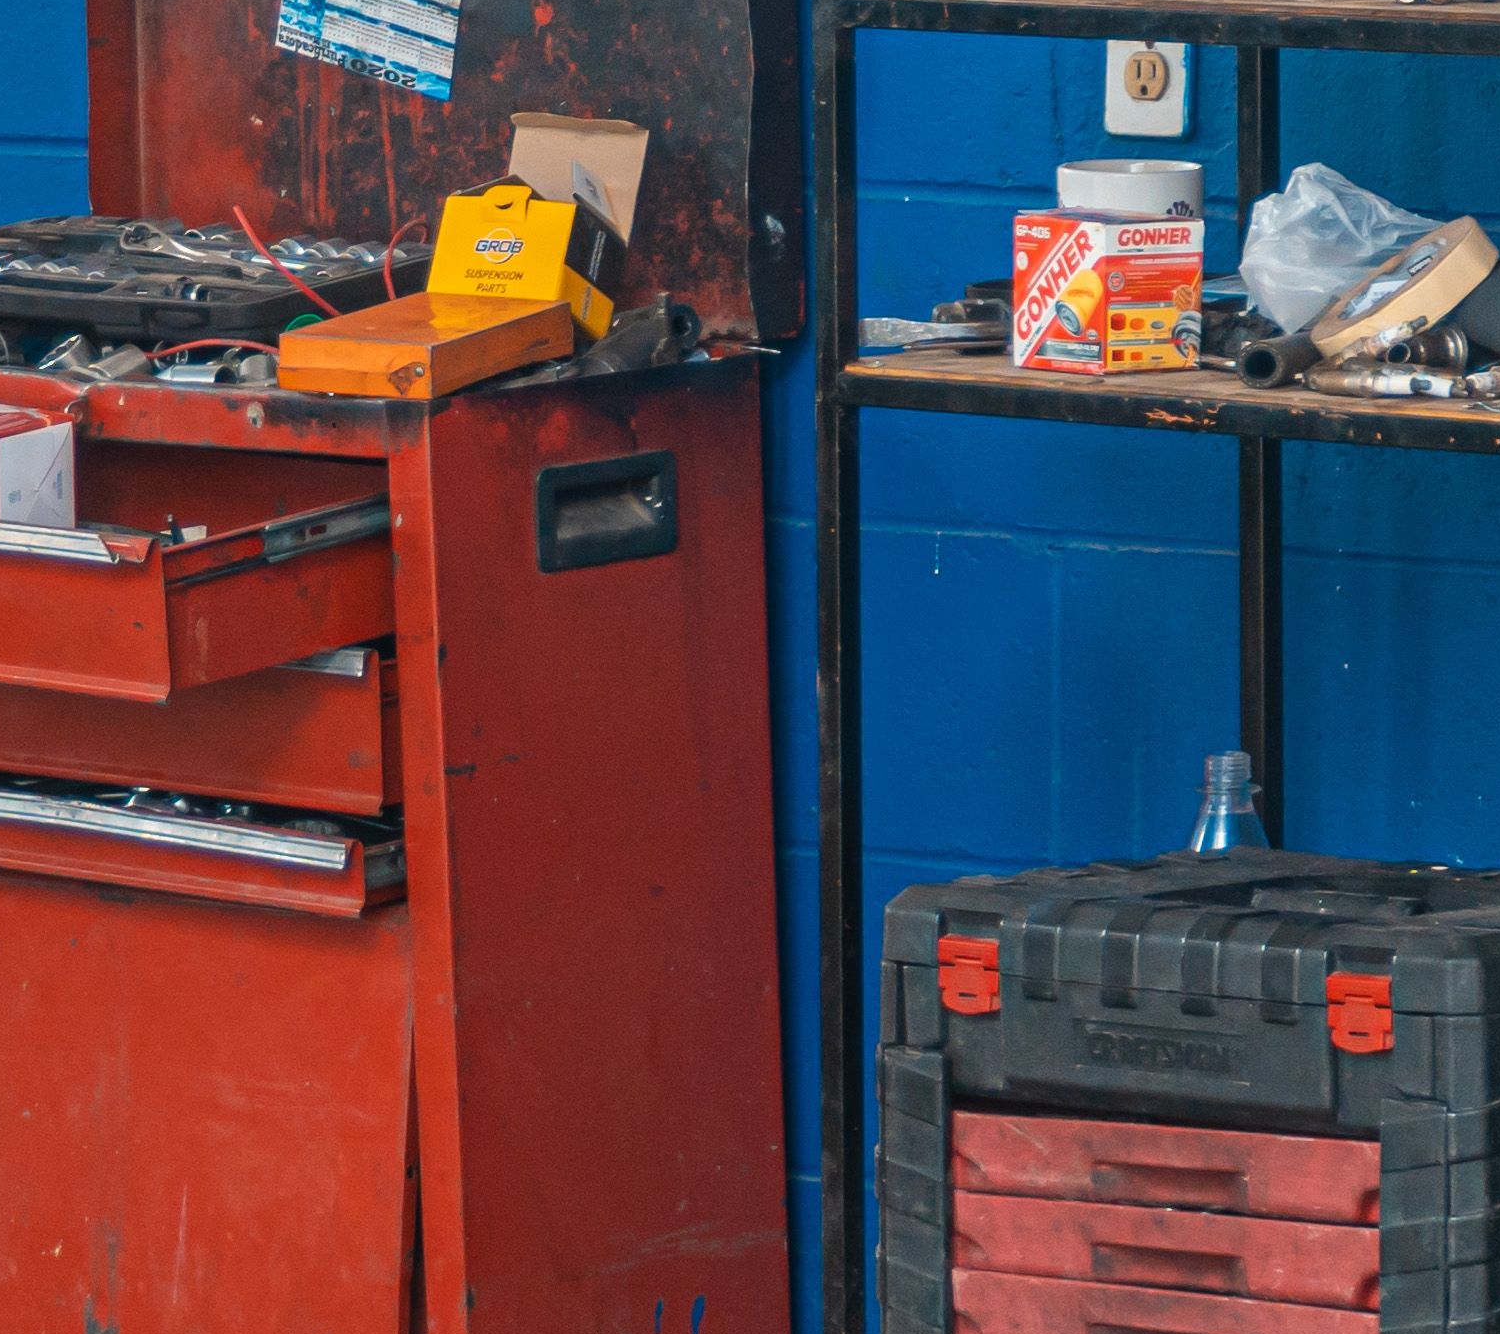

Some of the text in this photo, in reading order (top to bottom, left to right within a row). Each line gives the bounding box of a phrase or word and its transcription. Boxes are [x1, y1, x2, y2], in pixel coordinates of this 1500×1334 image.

[349, 58, 417, 88] 2020
[1117, 227, 1192, 247] GONHER
[475, 239, 524, 254] GROB
[464, 268, 524, 281] SUSPENSION
[476, 283, 508, 294] PARTS
[1016, 229, 1095, 341] GONHER
